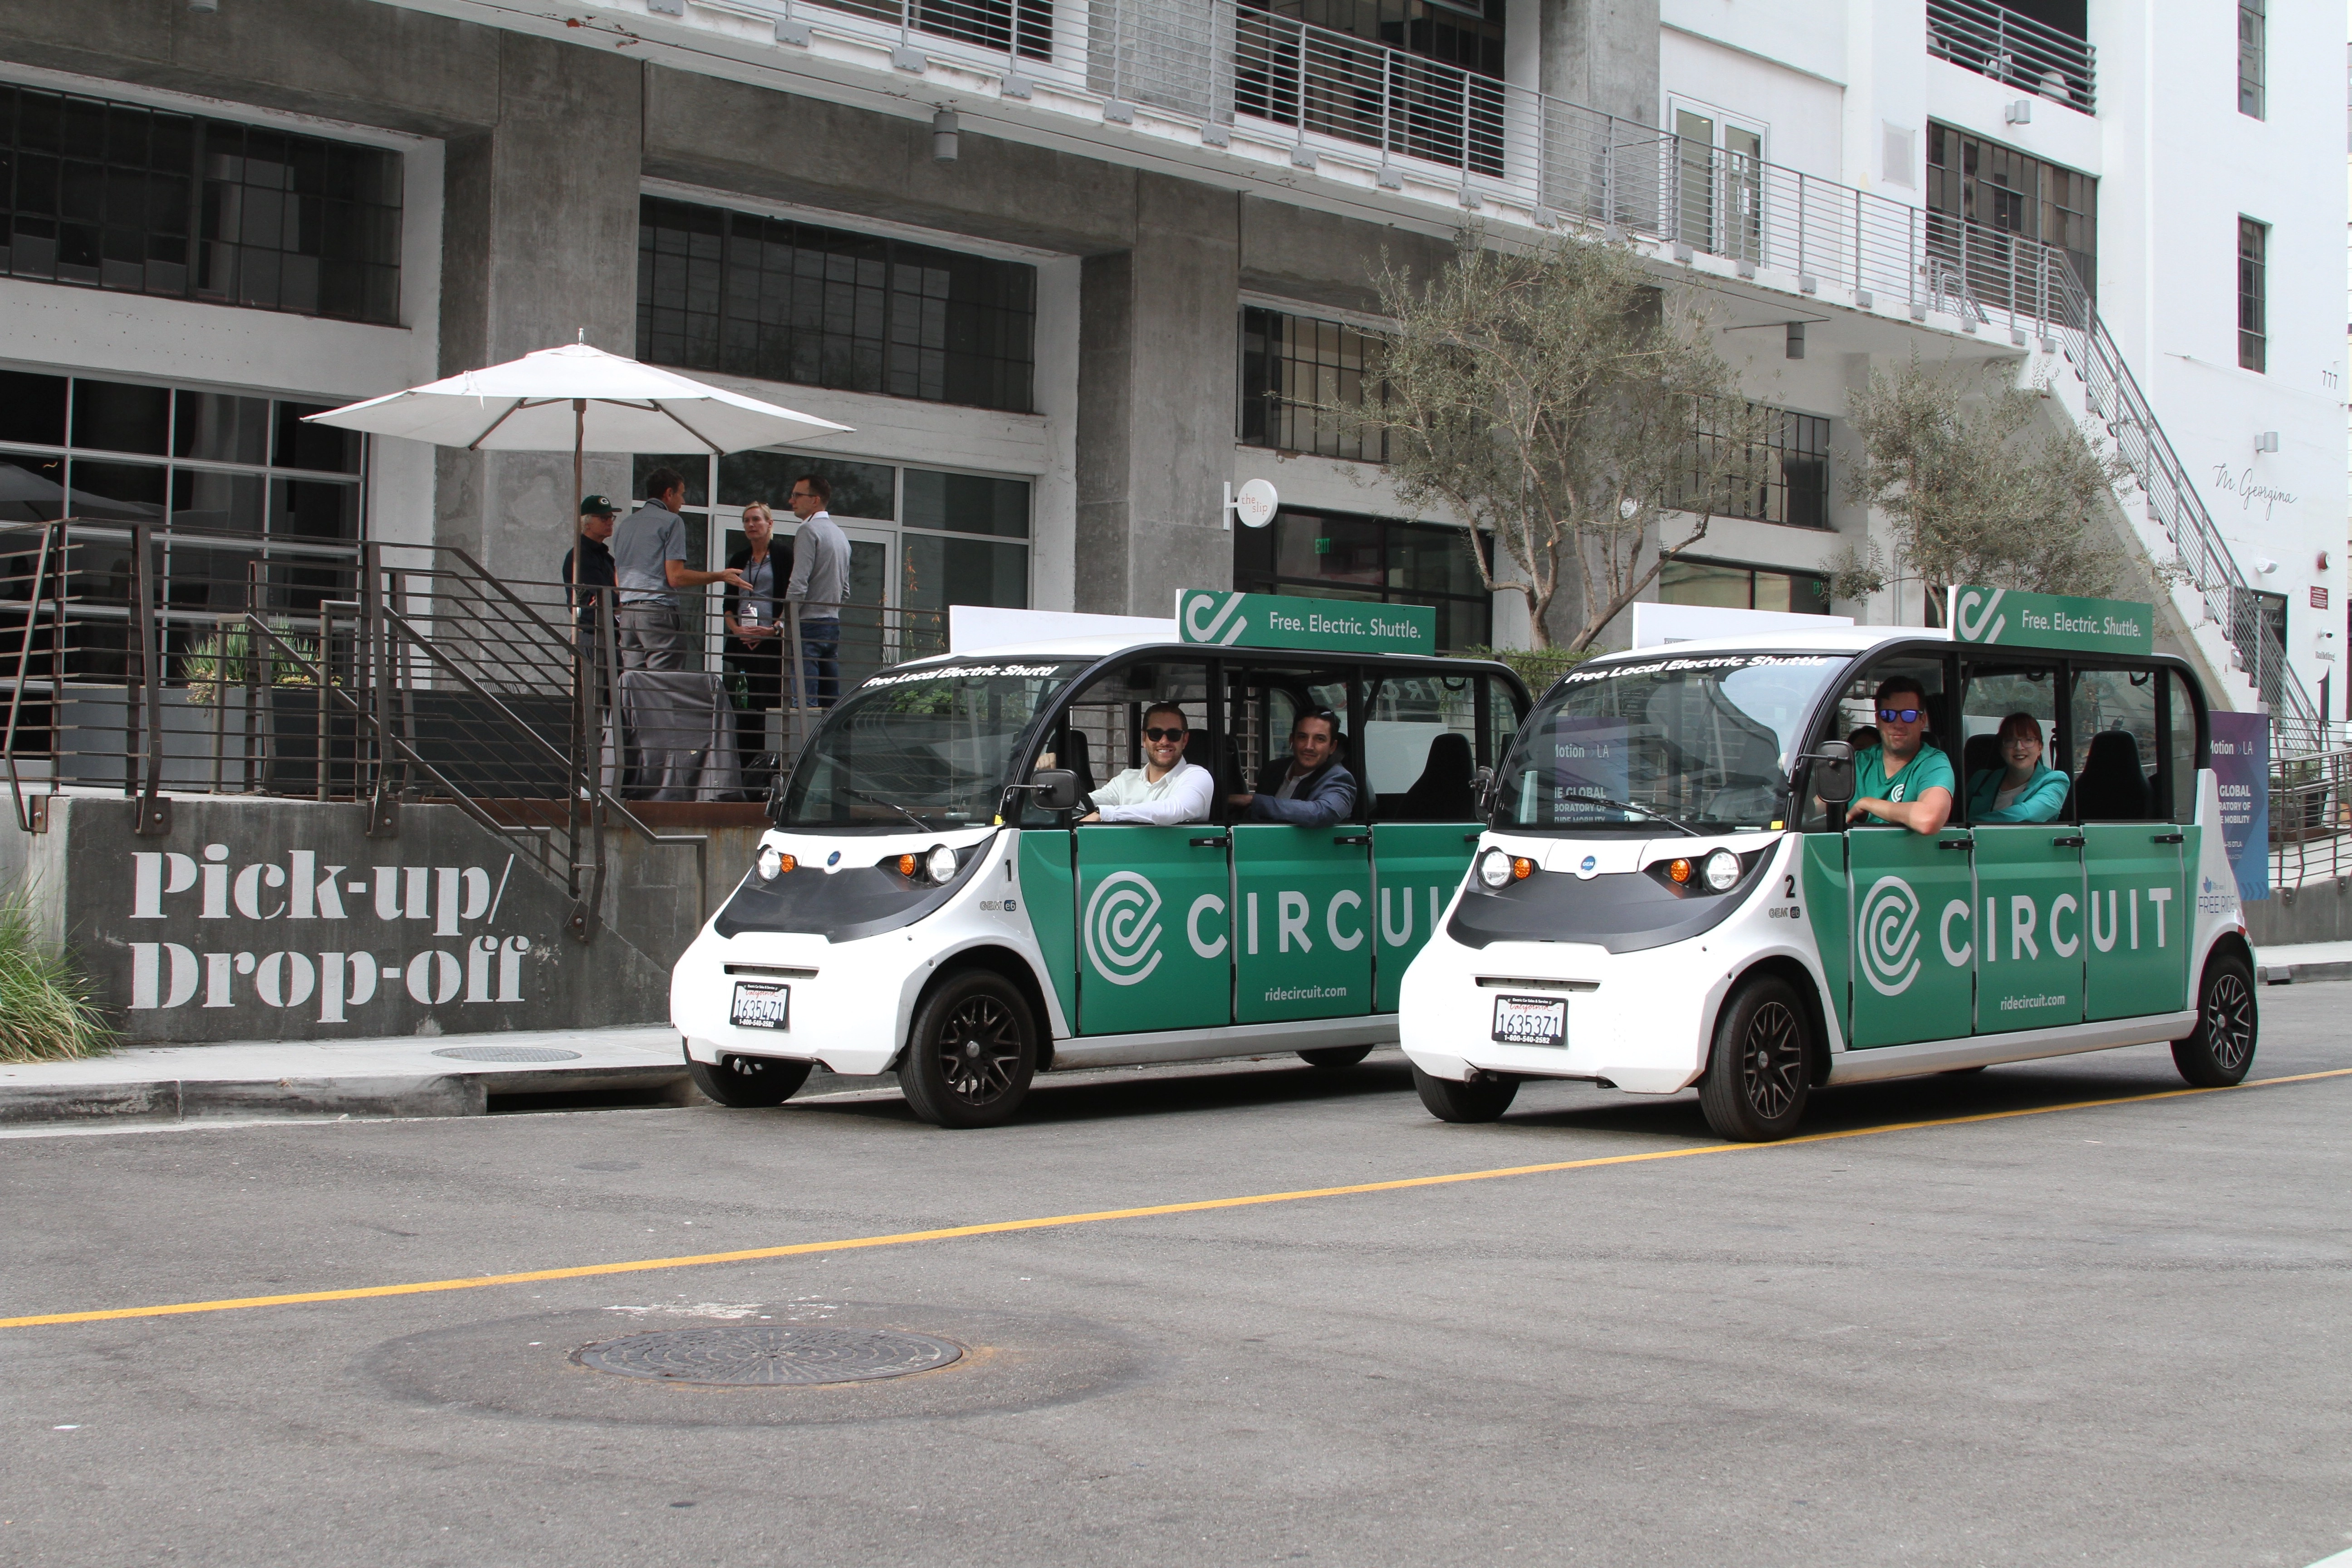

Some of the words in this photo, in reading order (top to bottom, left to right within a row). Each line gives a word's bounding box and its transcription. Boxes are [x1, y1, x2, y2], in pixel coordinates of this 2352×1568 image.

[2322, 370, 2337, 389] 777
[1242, 494, 1255, 505] the
[2239, 468, 2298, 521] Georgina
[1252, 502, 1268, 515] slip
[1315, 538, 1330, 554] EXIT
[1270, 612, 1304, 631] Free.
[1310, 614, 1365, 635] Electric.
[1370, 618, 1421, 638] Shuttle.
[2022, 609, 2050, 630] Free.
[2054, 612, 2100, 633] Electric.
[2103, 617, 2141, 637] Shuttle.
[2315, 651, 2335, 663] Building
[862, 676, 897, 688] Free
[895, 668, 944, 683] Local
[937, 665, 1001, 678] Electric
[1564, 669, 1607, 684] Free
[1608, 661, 1668, 678] Local
[1664, 656, 1745, 671] Electric
[1747, 656, 1828, 667] Shuttle
[2317, 665, 2332, 727] 1
[1597, 745, 1609, 758] LA
[2243, 741, 2253, 755] LA
[1566, 787, 1606, 799] GLOBAL
[2220, 785, 2251, 797] GLOBAL
[1555, 804, 1594, 812] BORATORY
[2219, 802, 2241, 811] RATORY
[2243, 802, 2251, 810] OF
[2225, 815, 2250, 823] MOBILITY
[1005, 859, 1012, 881] 1
[129, 844, 514, 936] Pick-up/
[1785, 875, 1795, 898] 2
[980, 901, 1001, 911] GEM
[1005, 902, 1016, 910] e6
[2199, 896, 2219, 913] FREE
[2221, 896, 2234, 913] RIDE
[1769, 908, 1788, 918] GEM
[1792, 908, 1799, 917] e6
[1187, 886, 1458, 958] CIRCUI
[1940, 887, 2172, 967] CIRCUIT
[128, 936, 530, 1024] Drop-off
[746, 990, 779, 999] California
[1265, 985, 1347, 1001] ridecircuit.com
[735, 999, 782, 1021] 1635471
[1510, 1004, 1553, 1013] California
[2000, 994, 2065, 1010] ridecircuit.com
[1498, 1014, 1559, 1037] 1635371
[1504, 1034, 1550, 1044] 1-800-540-2582
